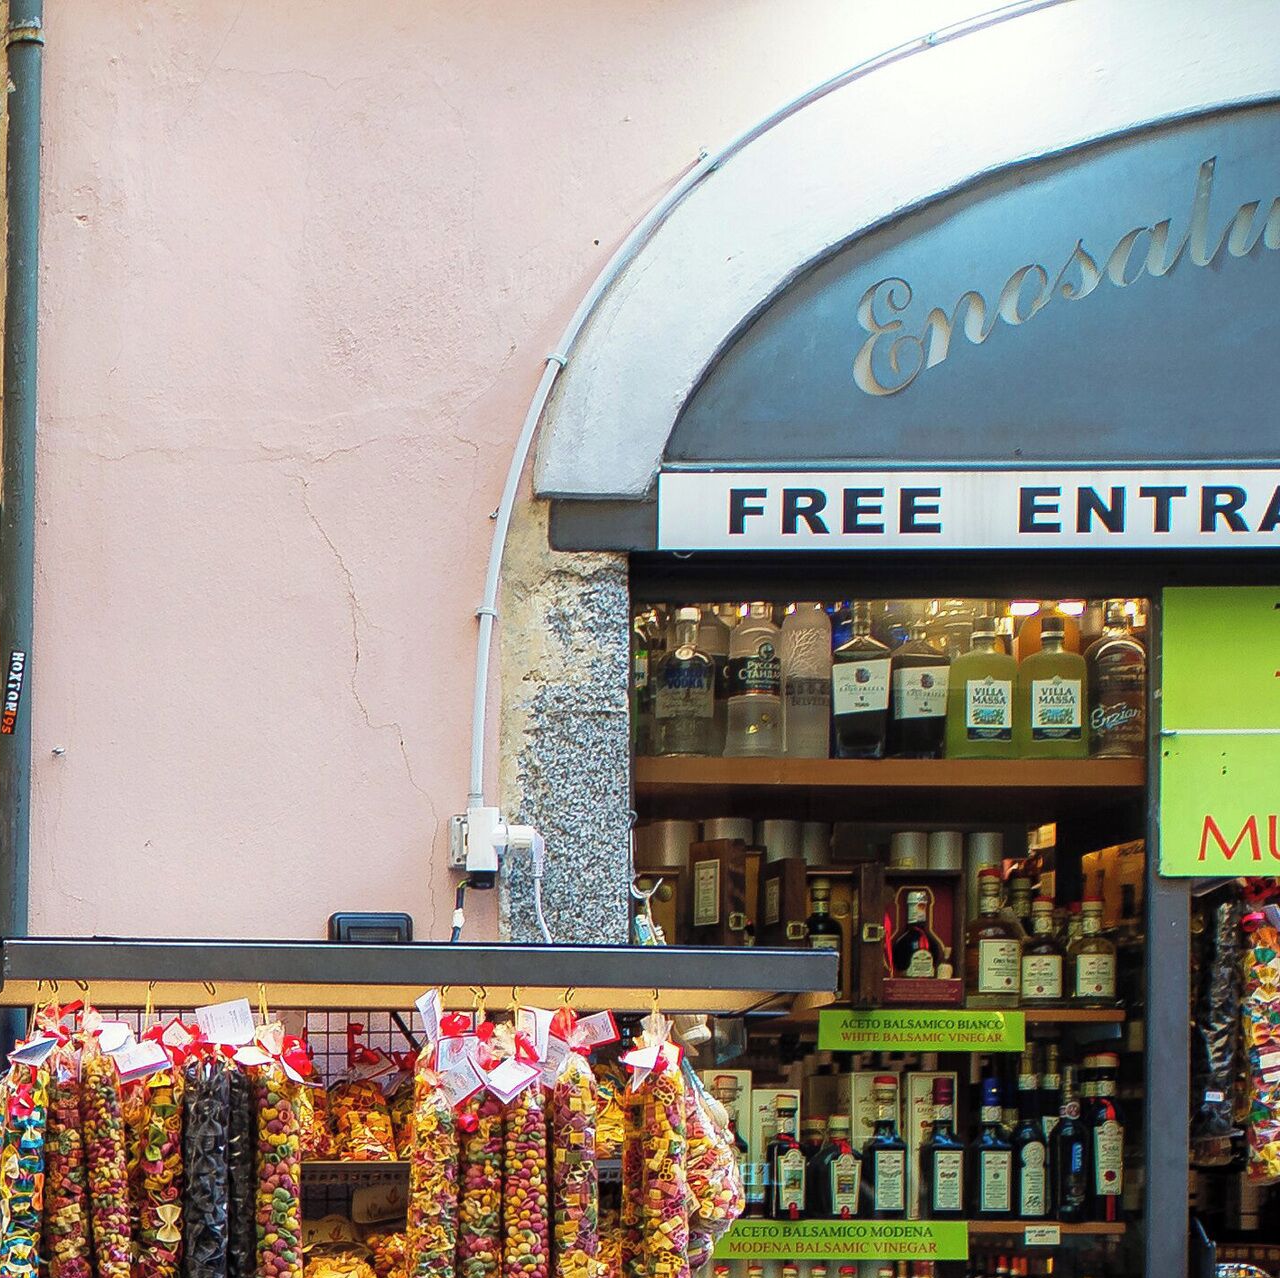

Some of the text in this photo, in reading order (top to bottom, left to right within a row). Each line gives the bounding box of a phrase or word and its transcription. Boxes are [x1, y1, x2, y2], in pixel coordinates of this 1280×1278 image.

[728, 487, 942, 535] FREE
[974, 687, 1004, 696] VILLA
[1041, 687, 1072, 696] VILLA
[972, 696, 1007, 705] MASSA
[1038, 696, 1076, 705] MASSA
[1198, 815, 1280, 861] M
[841, 1018, 1004, 1029] ACETO BALSAMICO BIANCO
[841, 1032, 1003, 1043] WHITE BALSAMIC VINEGAR
[731, 1226, 933, 1238] ACETO BALSAMICO MODENA
[730, 1241, 938, 1254] MODENA BALSAMIC VINEGAR
